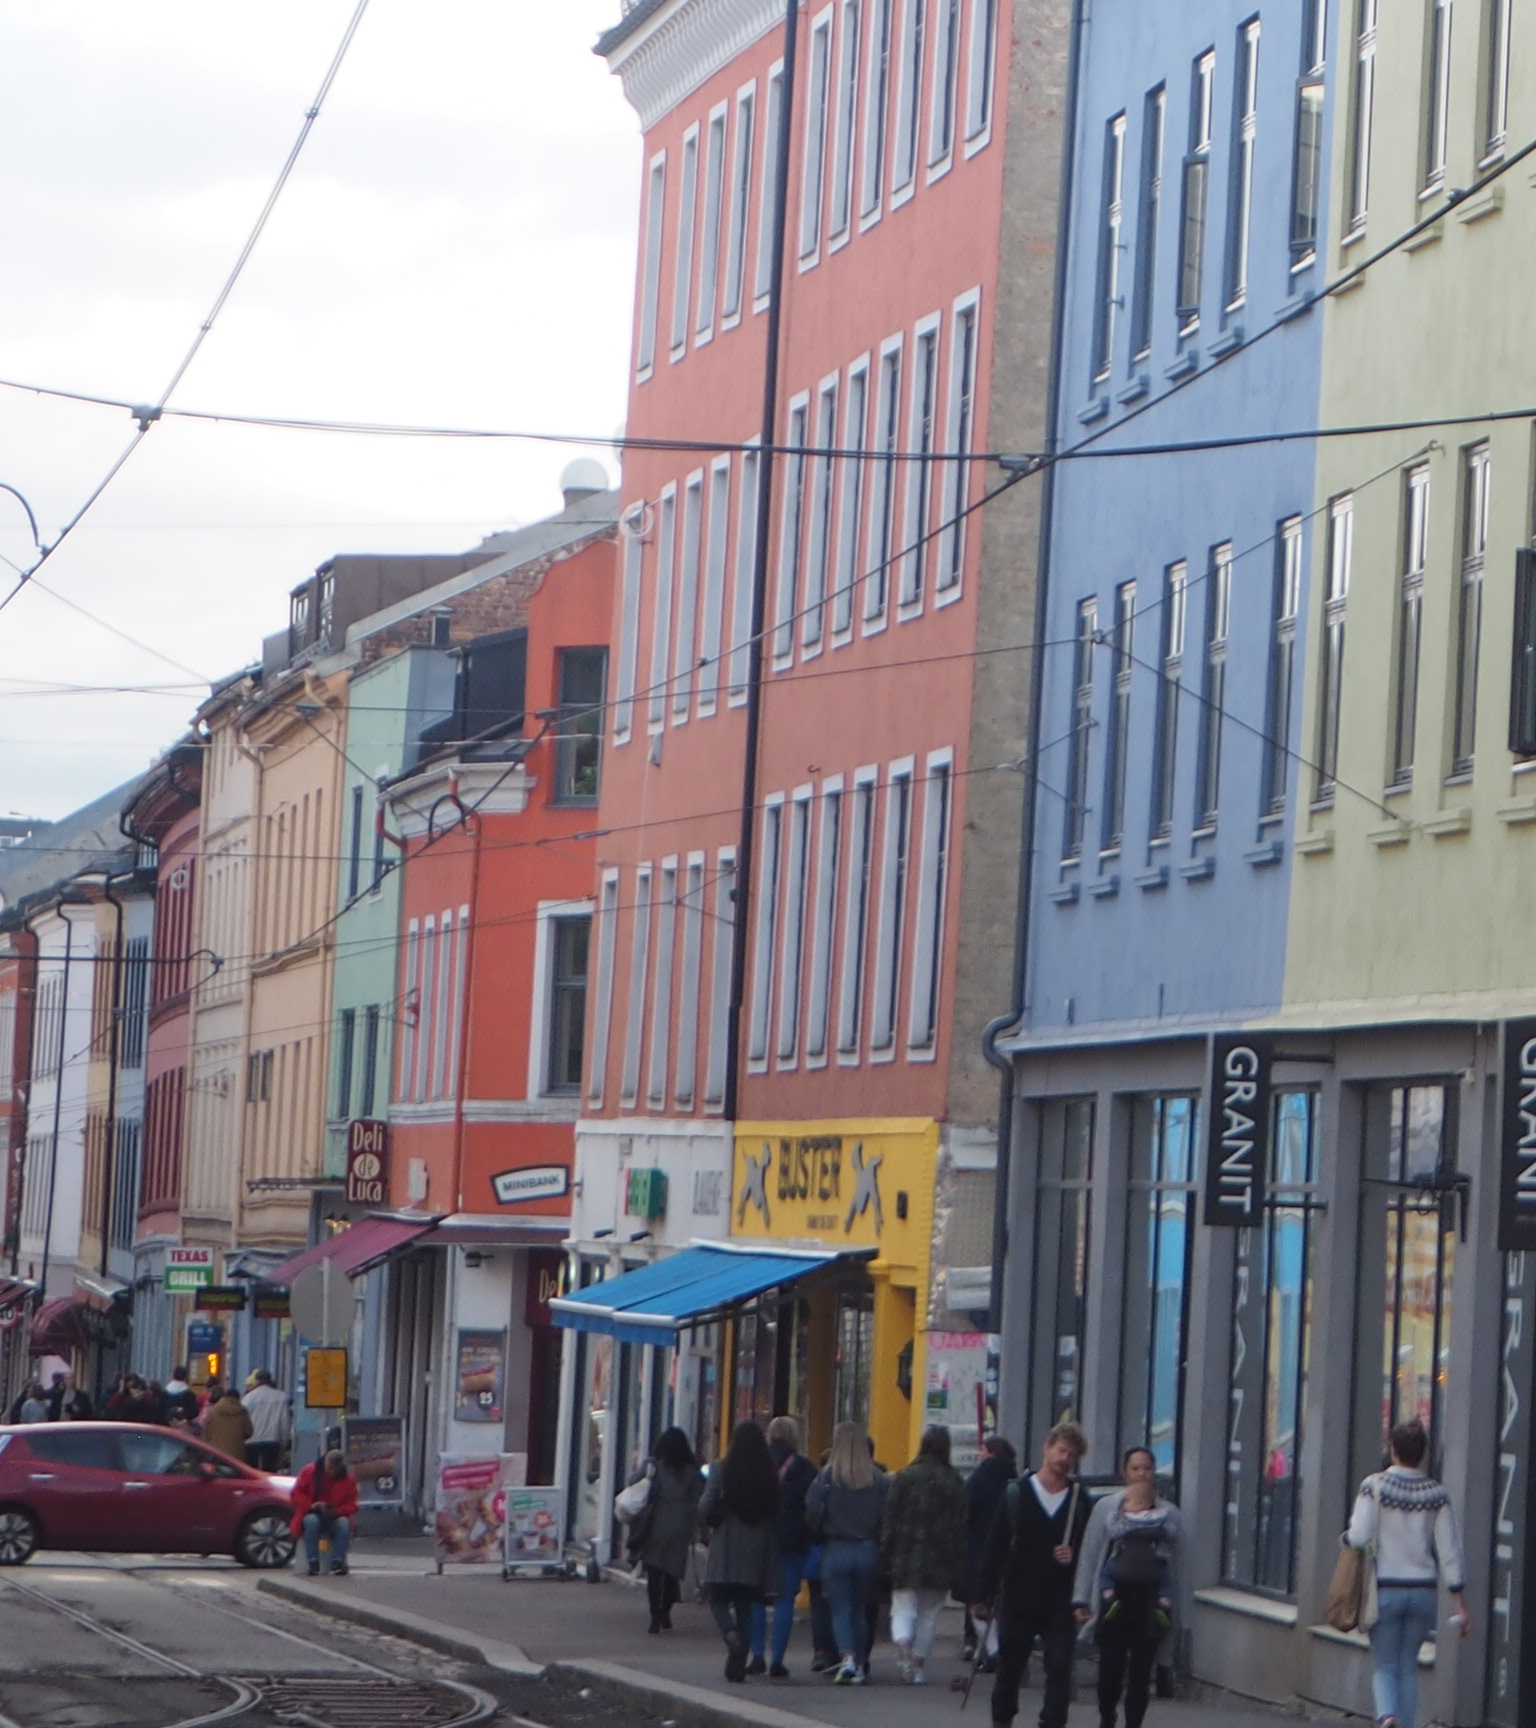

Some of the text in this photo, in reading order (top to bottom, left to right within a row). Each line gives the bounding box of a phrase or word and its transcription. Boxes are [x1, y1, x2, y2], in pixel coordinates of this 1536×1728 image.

[353, 1121, 383, 1152] Deli
[1217, 1046, 1259, 1214] GRANIT
[358, 1153, 374, 1178] de
[777, 1137, 843, 1200] BUSTER
[348, 1172, 383, 1202] Luca
[502, 1175, 560, 1192] MINIBANK
[171, 1250, 209, 1262] TEXAS
[169, 1271, 208, 1286] GRILL
